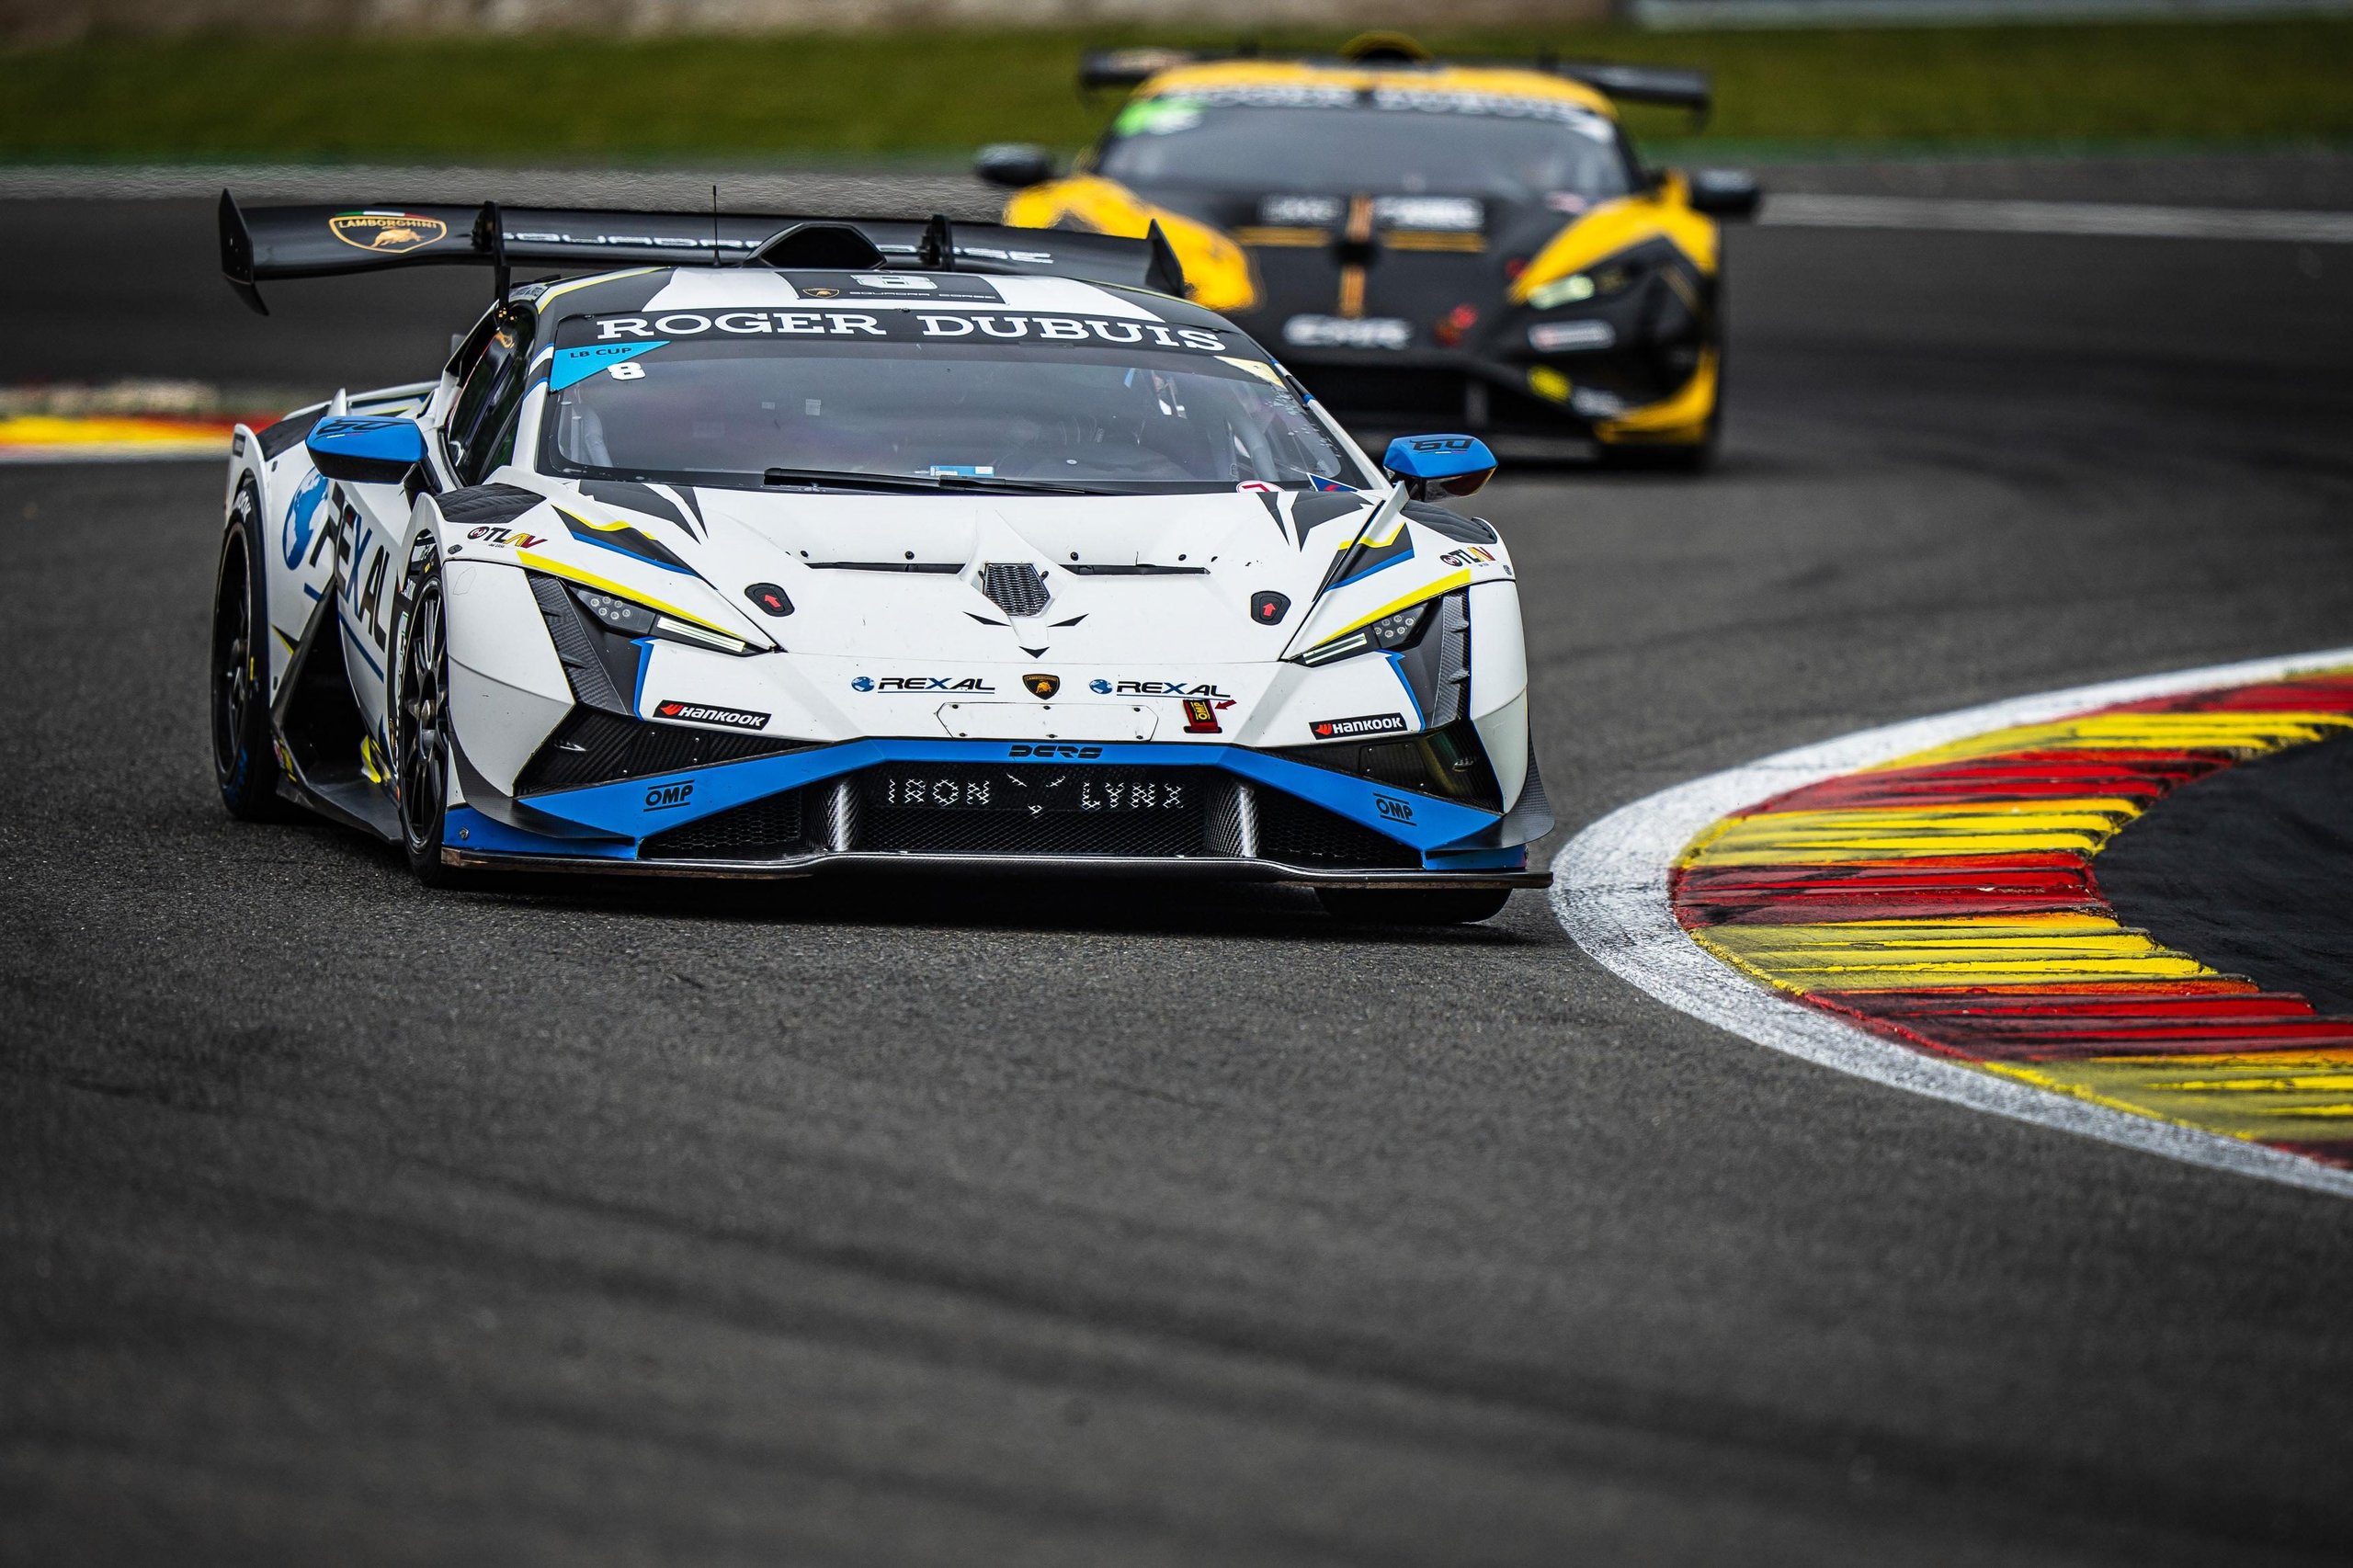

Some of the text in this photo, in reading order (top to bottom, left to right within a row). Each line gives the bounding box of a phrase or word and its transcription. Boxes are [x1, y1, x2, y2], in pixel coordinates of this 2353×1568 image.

[338, 219, 438, 229] LAMBORGHINI
[597, 312, 1227, 352] ROGER DUBUIS
[596, 347, 632, 357] CUP
[608, 362, 645, 381] 8
[309, 482, 390, 653] REXAL
[878, 677, 995, 691] REXAL
[1116, 681, 1231, 699] REXAL
[1194, 701, 1208, 720] OMP
[645, 784, 694, 807] OMP
[889, 779, 1184, 811] IRON LYNX
[1376, 797, 1414, 822] OMP
